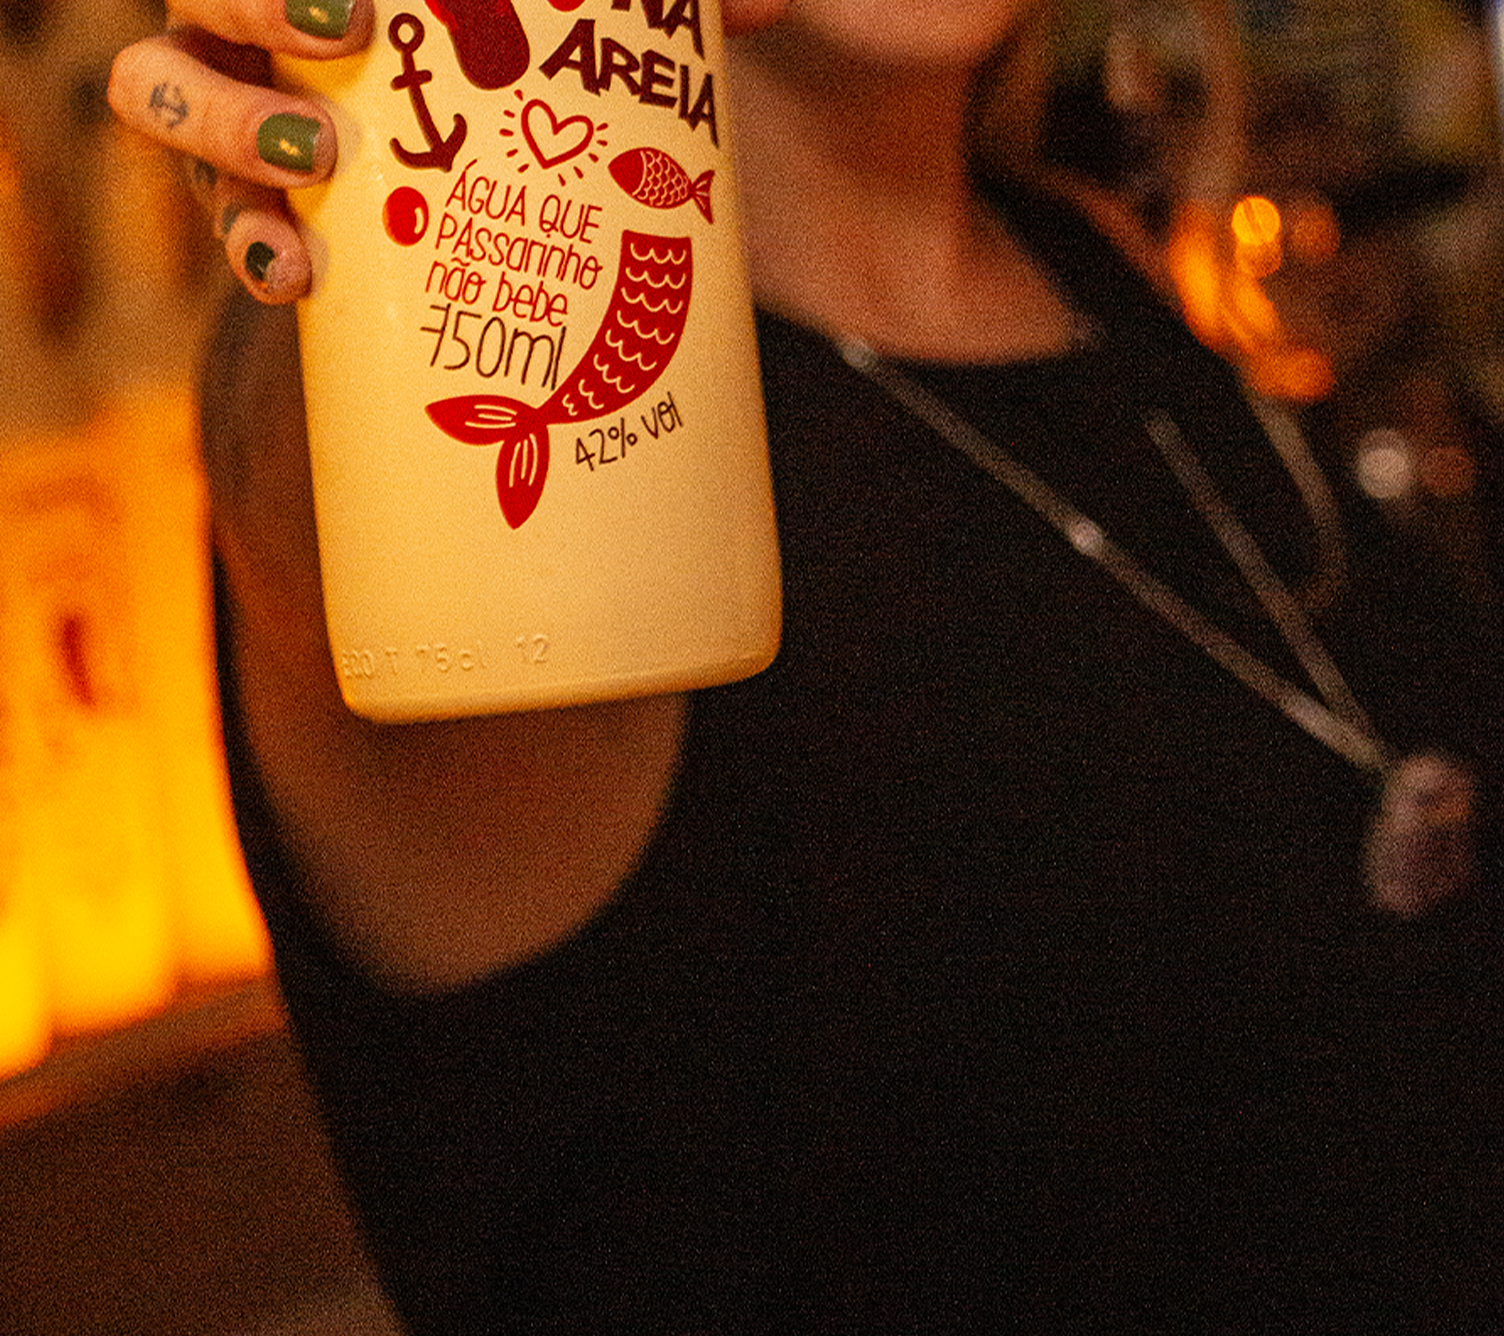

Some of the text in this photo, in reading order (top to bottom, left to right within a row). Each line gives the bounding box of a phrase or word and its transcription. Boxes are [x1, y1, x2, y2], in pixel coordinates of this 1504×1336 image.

[539, 19, 719, 149] AREIA
[444, 158, 603, 244] ÁGUA QUE
[425, 257, 568, 326] não bebe
[419, 303, 568, 391] 750ml
[575, 417, 638, 472] 42%
